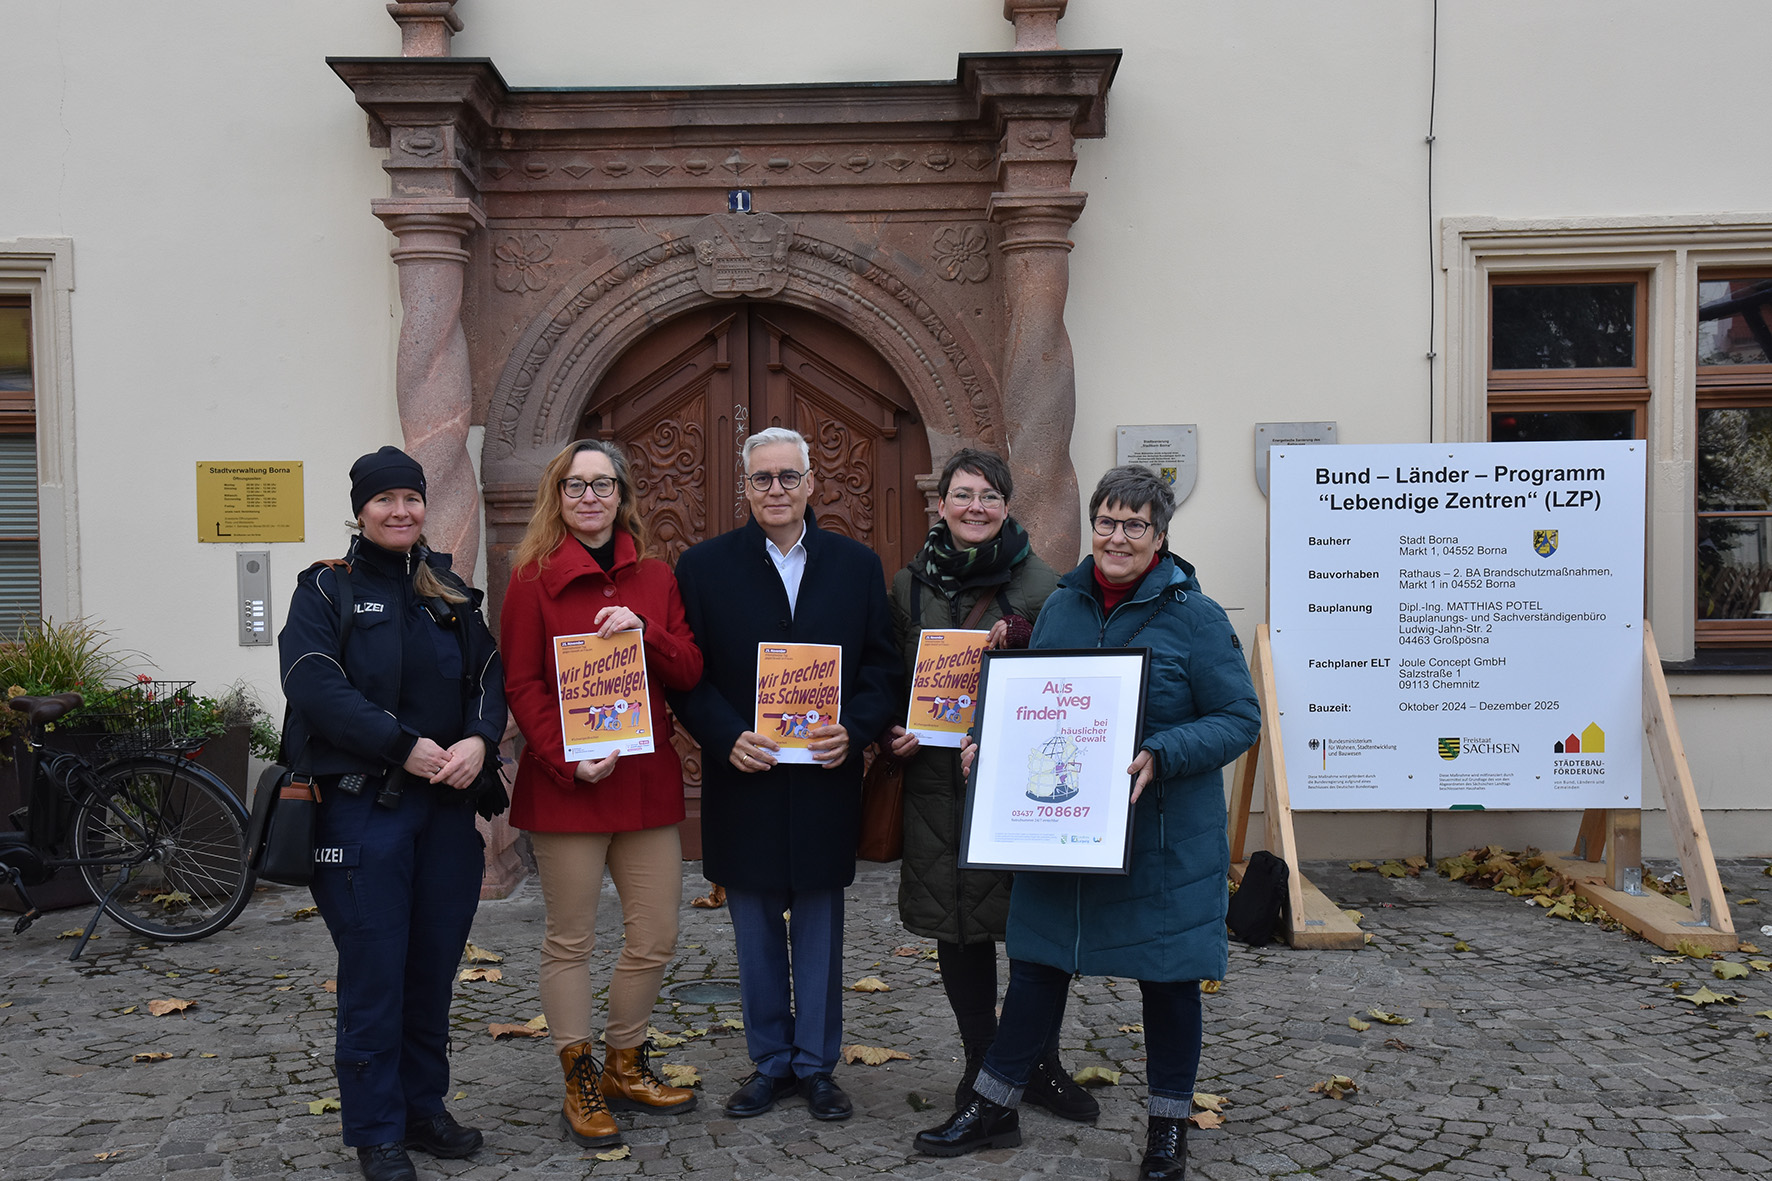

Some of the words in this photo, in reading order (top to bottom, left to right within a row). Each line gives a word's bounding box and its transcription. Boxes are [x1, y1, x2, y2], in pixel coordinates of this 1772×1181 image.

[736, 193, 743, 210] 1
[735, 404, 748, 420] 20
[1316, 468, 1370, 484] Bund
[1397, 467, 1469, 483] Länder
[1495, 466, 1604, 486] Programm
[1545, 490, 1601, 512] (LZP)
[1309, 537, 1351, 545] Bauherr
[1400, 536, 1425, 545] Stadt
[1429, 535, 1458, 544] Borna
[1400, 547, 1427, 556] Markt
[1431, 547, 1439, 556] 1,
[1443, 546, 1474, 555] 04552
[1478, 546, 1507, 555] Borna
[1309, 570, 1379, 579] Bauvorhaben
[1400, 569, 1441, 578] Rathaus
[1453, 568, 1462, 577] 2.
[1466, 568, 1481, 577] BA
[1484, 567, 1612, 577] Brandschutzmaßnahmen,
[1400, 580, 1427, 589] Markt
[1431, 580, 1435, 588] 1
[1440, 580, 1448, 588] in
[1451, 579, 1482, 589] 04552
[1486, 579, 1515, 588] Borna
[353, 602, 384, 613] LIZEI
[1309, 604, 1372, 614] Bauplanung
[1400, 603, 1443, 613] Dipl.-Ing.
[1447, 601, 1503, 611] MATTHIAS
[1506, 601, 1543, 610] POTEL
[1399, 612, 1470, 625] Bauplanungs-
[1471, 613, 1489, 622] und
[1493, 612, 1606, 623] Sachverständigenbüro
[1399, 623, 1482, 636] Ludwig-Jahn-Str.
[1486, 624, 1492, 632] 2
[1399, 636, 1430, 645] 04463
[1432, 634, 1489, 646] Großpösna
[560, 667, 580, 686] Wir
[583, 644, 637, 679] brechen
[1309, 659, 1368, 670] Fachplaner
[1371, 658, 1390, 667] ELT
[1399, 658, 1425, 667] Joule
[1429, 658, 1470, 670] Concept
[1474, 657, 1506, 666] GmbH
[758, 673, 779, 690] Wir
[780, 659, 835, 685] brechen
[1399, 669, 1452, 678] Salzstraße
[1456, 669, 1460, 677] 1
[1042, 681, 1073, 694] Aus
[1399, 680, 1429, 689] 09113
[1432, 680, 1479, 689] Chemnitz
[1056, 696, 1090, 709] weg
[1309, 703, 1351, 712] Bauzeit:
[1399, 702, 1439, 711] Oktober
[1442, 702, 1466, 711] 2024
[1480, 702, 1531, 710] Dezember
[1534, 701, 1559, 710] 2025
[1016, 706, 1067, 720] finden
[1094, 719, 1108, 727] bei
[1061, 727, 1107, 735] häuslicher
[1075, 735, 1106, 743] Gewalt
[1463, 744, 1519, 754] SACHSEN
